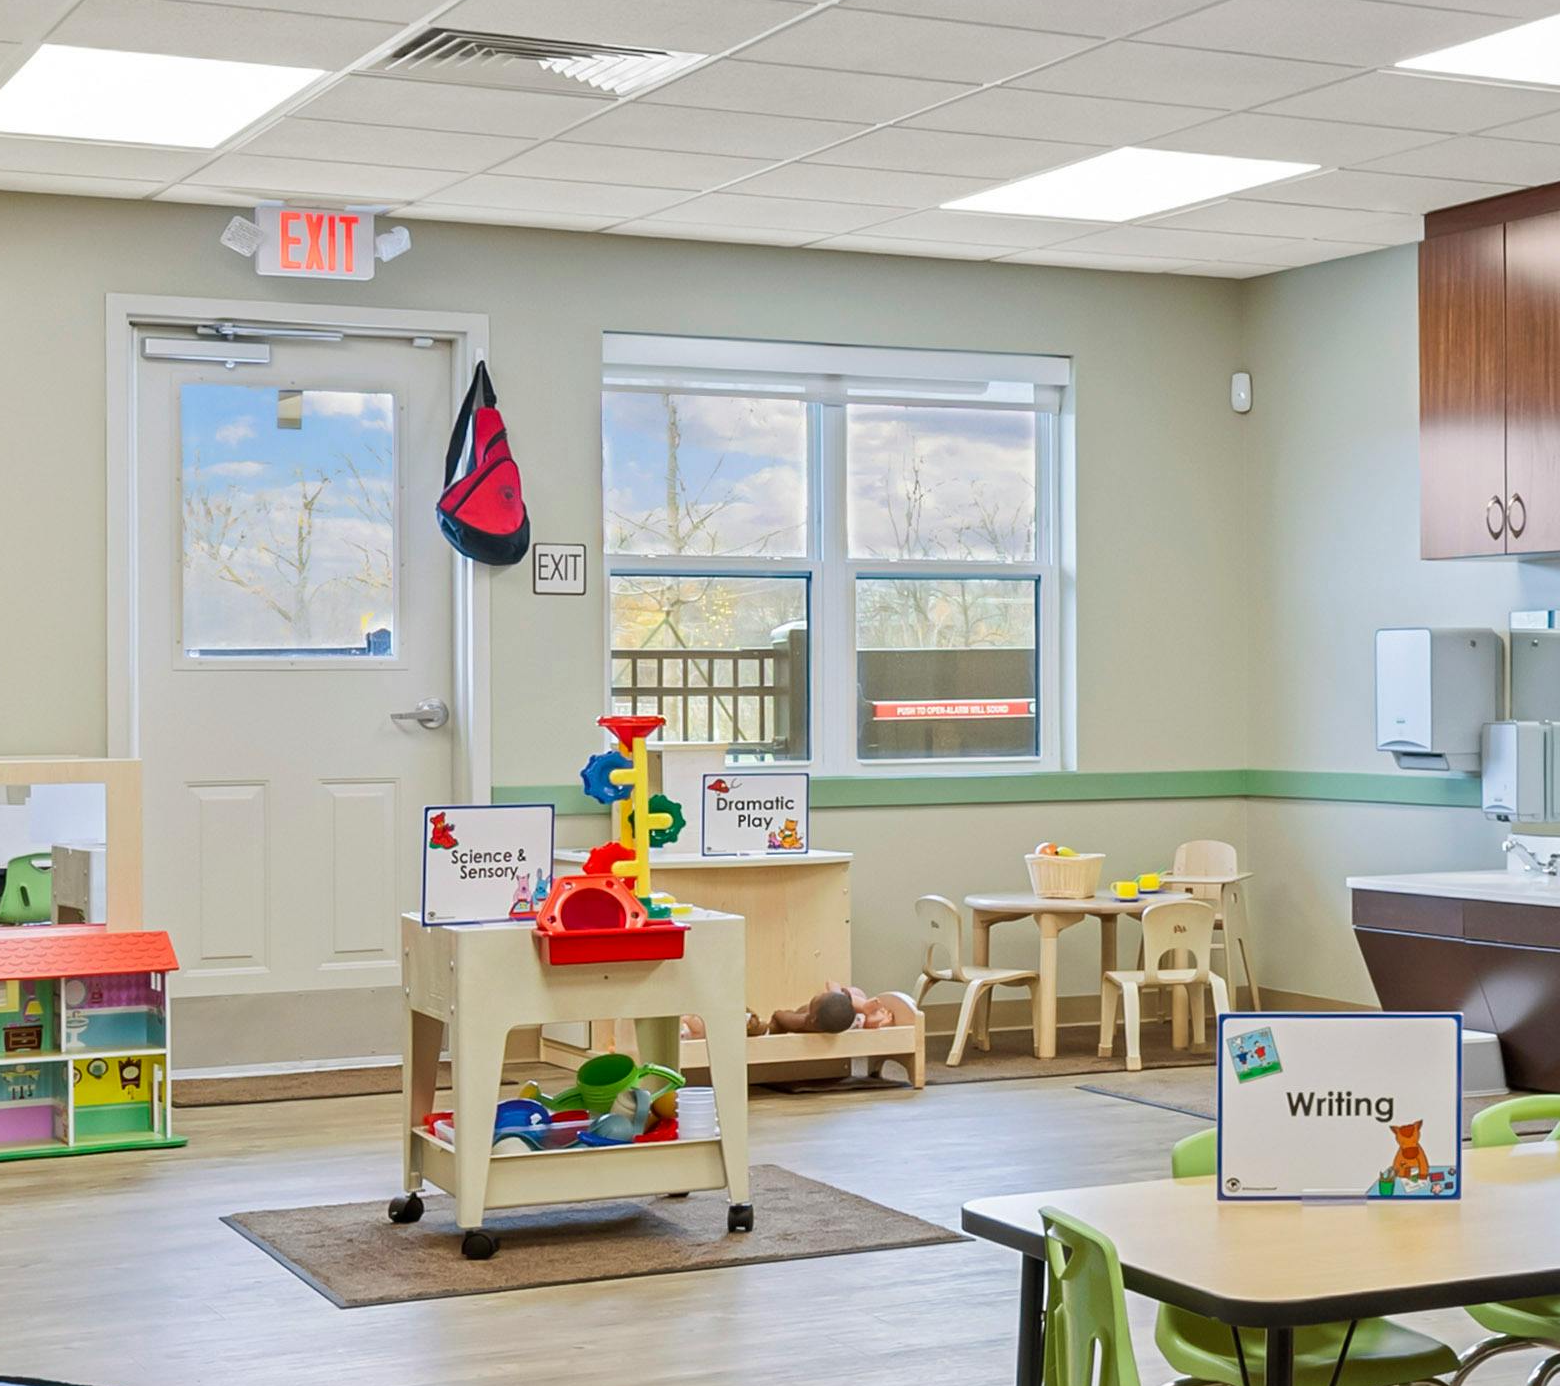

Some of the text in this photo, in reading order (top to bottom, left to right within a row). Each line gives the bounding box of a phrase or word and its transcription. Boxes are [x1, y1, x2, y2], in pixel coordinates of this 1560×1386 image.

[279, 210, 360, 273] EXIT
[538, 553, 582, 581] EXIT
[896, 706, 915, 716] PUSH
[916, 706, 926, 716] TO
[970, 704, 985, 714] WILL
[986, 704, 1009, 714] SOUND
[716, 795, 795, 812] Dramatic
[737, 813, 773, 831] Play
[450, 848, 527, 866] Science &
[459, 864, 518, 881] Sensory
[1286, 1090, 1395, 1123] Writing
